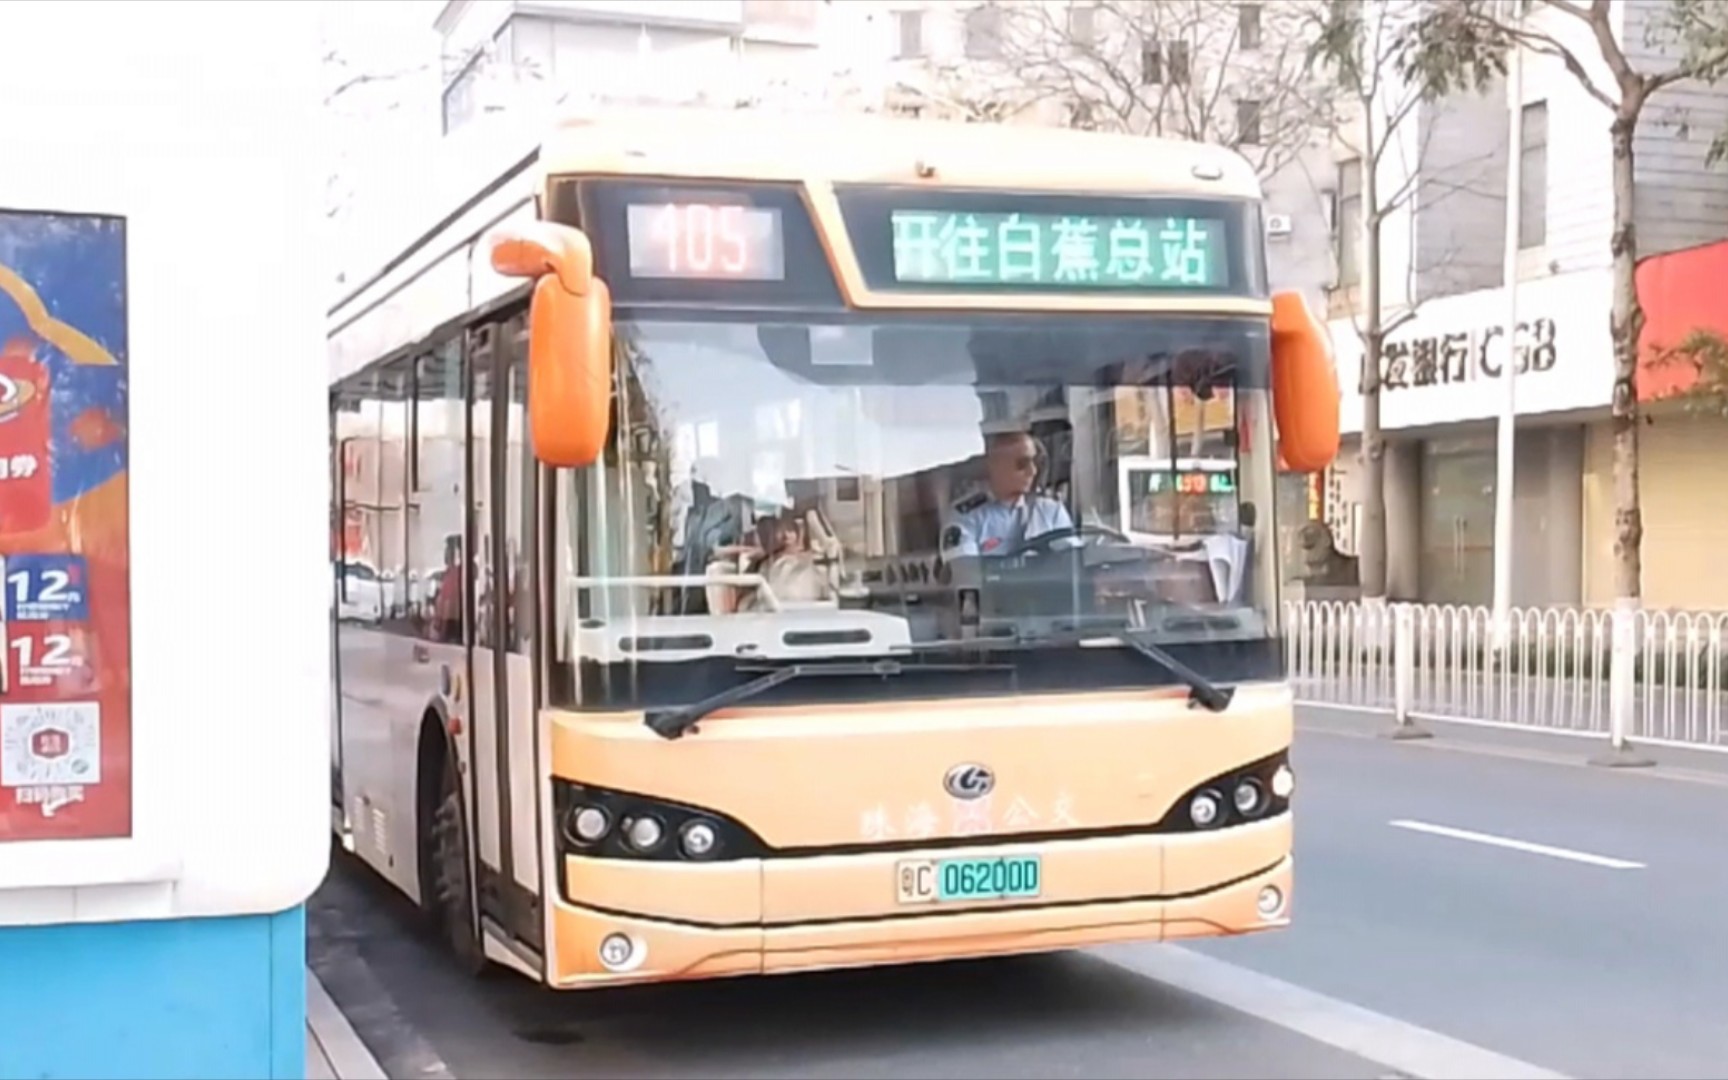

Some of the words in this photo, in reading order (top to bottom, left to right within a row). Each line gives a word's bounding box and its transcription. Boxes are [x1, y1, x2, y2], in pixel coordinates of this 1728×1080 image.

[658, 203, 747, 272] 105
[892, 211, 1207, 284] 开往白蕉总站
[944, 860, 1038, 895] 06200D
